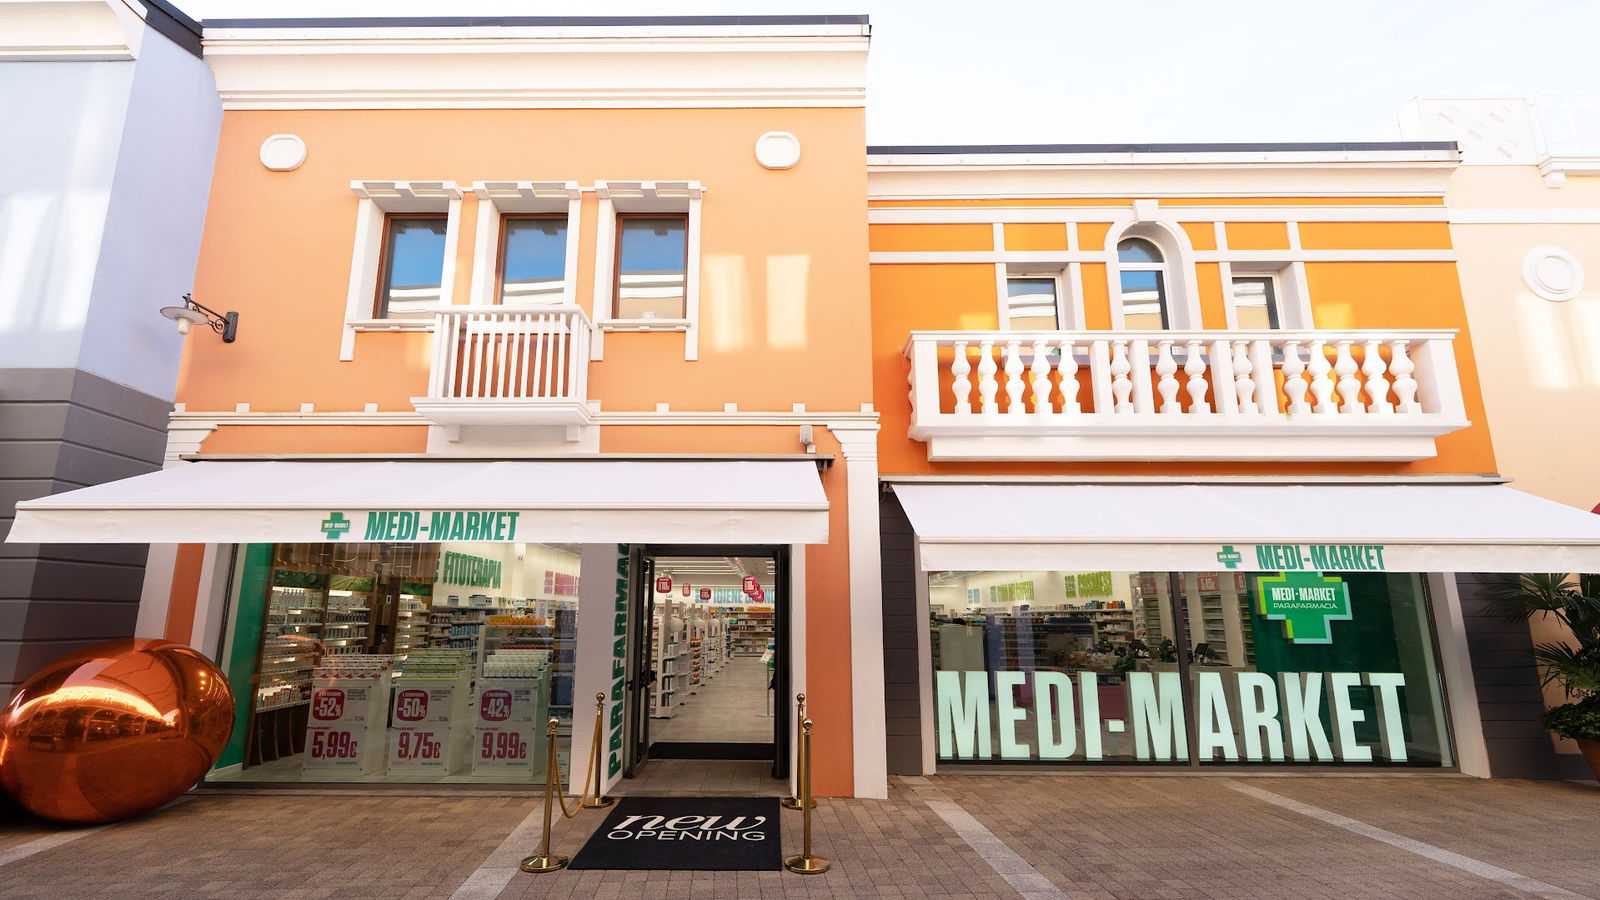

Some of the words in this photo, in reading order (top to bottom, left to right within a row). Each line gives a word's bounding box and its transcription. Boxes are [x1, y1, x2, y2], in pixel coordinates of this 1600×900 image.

[364, 511, 520, 540] MEDI-MARKET
[443, 551, 502, 589] FITOTERAPIA
[1256, 545, 1385, 570] MEDI-MARKET
[714, 588, 743, 603] IGIENE
[315, 697, 341, 717] -52%
[398, 698, 426, 717] -50%
[482, 698, 510, 718] -42%
[936, 671, 1408, 762] MEDI-MARKET
[312, 731, 357, 760] 5,99€
[398, 732, 441, 760] 9,75€
[482, 732, 527, 760] 9,99€
[607, 830, 766, 841] OPENING
[613, 815, 767, 832] new
